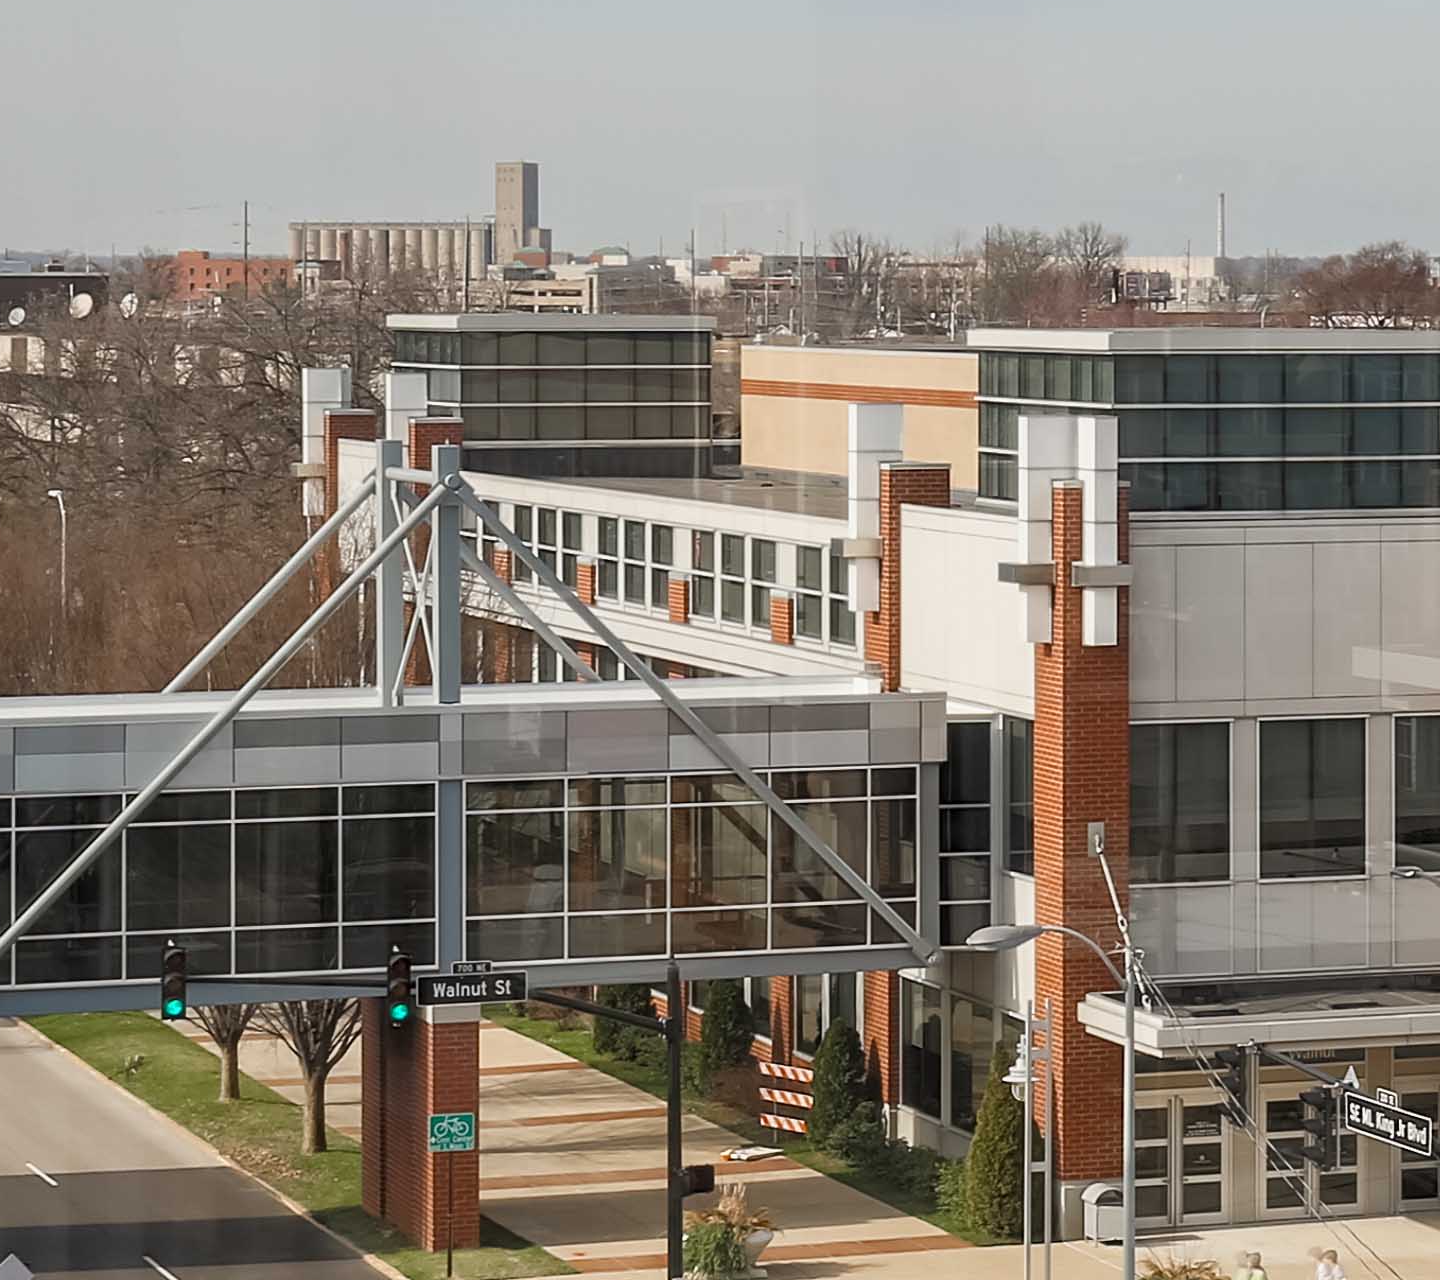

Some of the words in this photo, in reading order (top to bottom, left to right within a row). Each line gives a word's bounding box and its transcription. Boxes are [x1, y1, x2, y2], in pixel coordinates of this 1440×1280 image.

[433, 980, 487, 998] Walnut
[495, 979, 512, 995] St
[1349, 1102, 1361, 1122] SE
[1362, 1106, 1375, 1127] ML
[1376, 1111, 1395, 1139] King
[1396, 1119, 1406, 1138] Jr
[1407, 1121, 1427, 1145] Blvd
